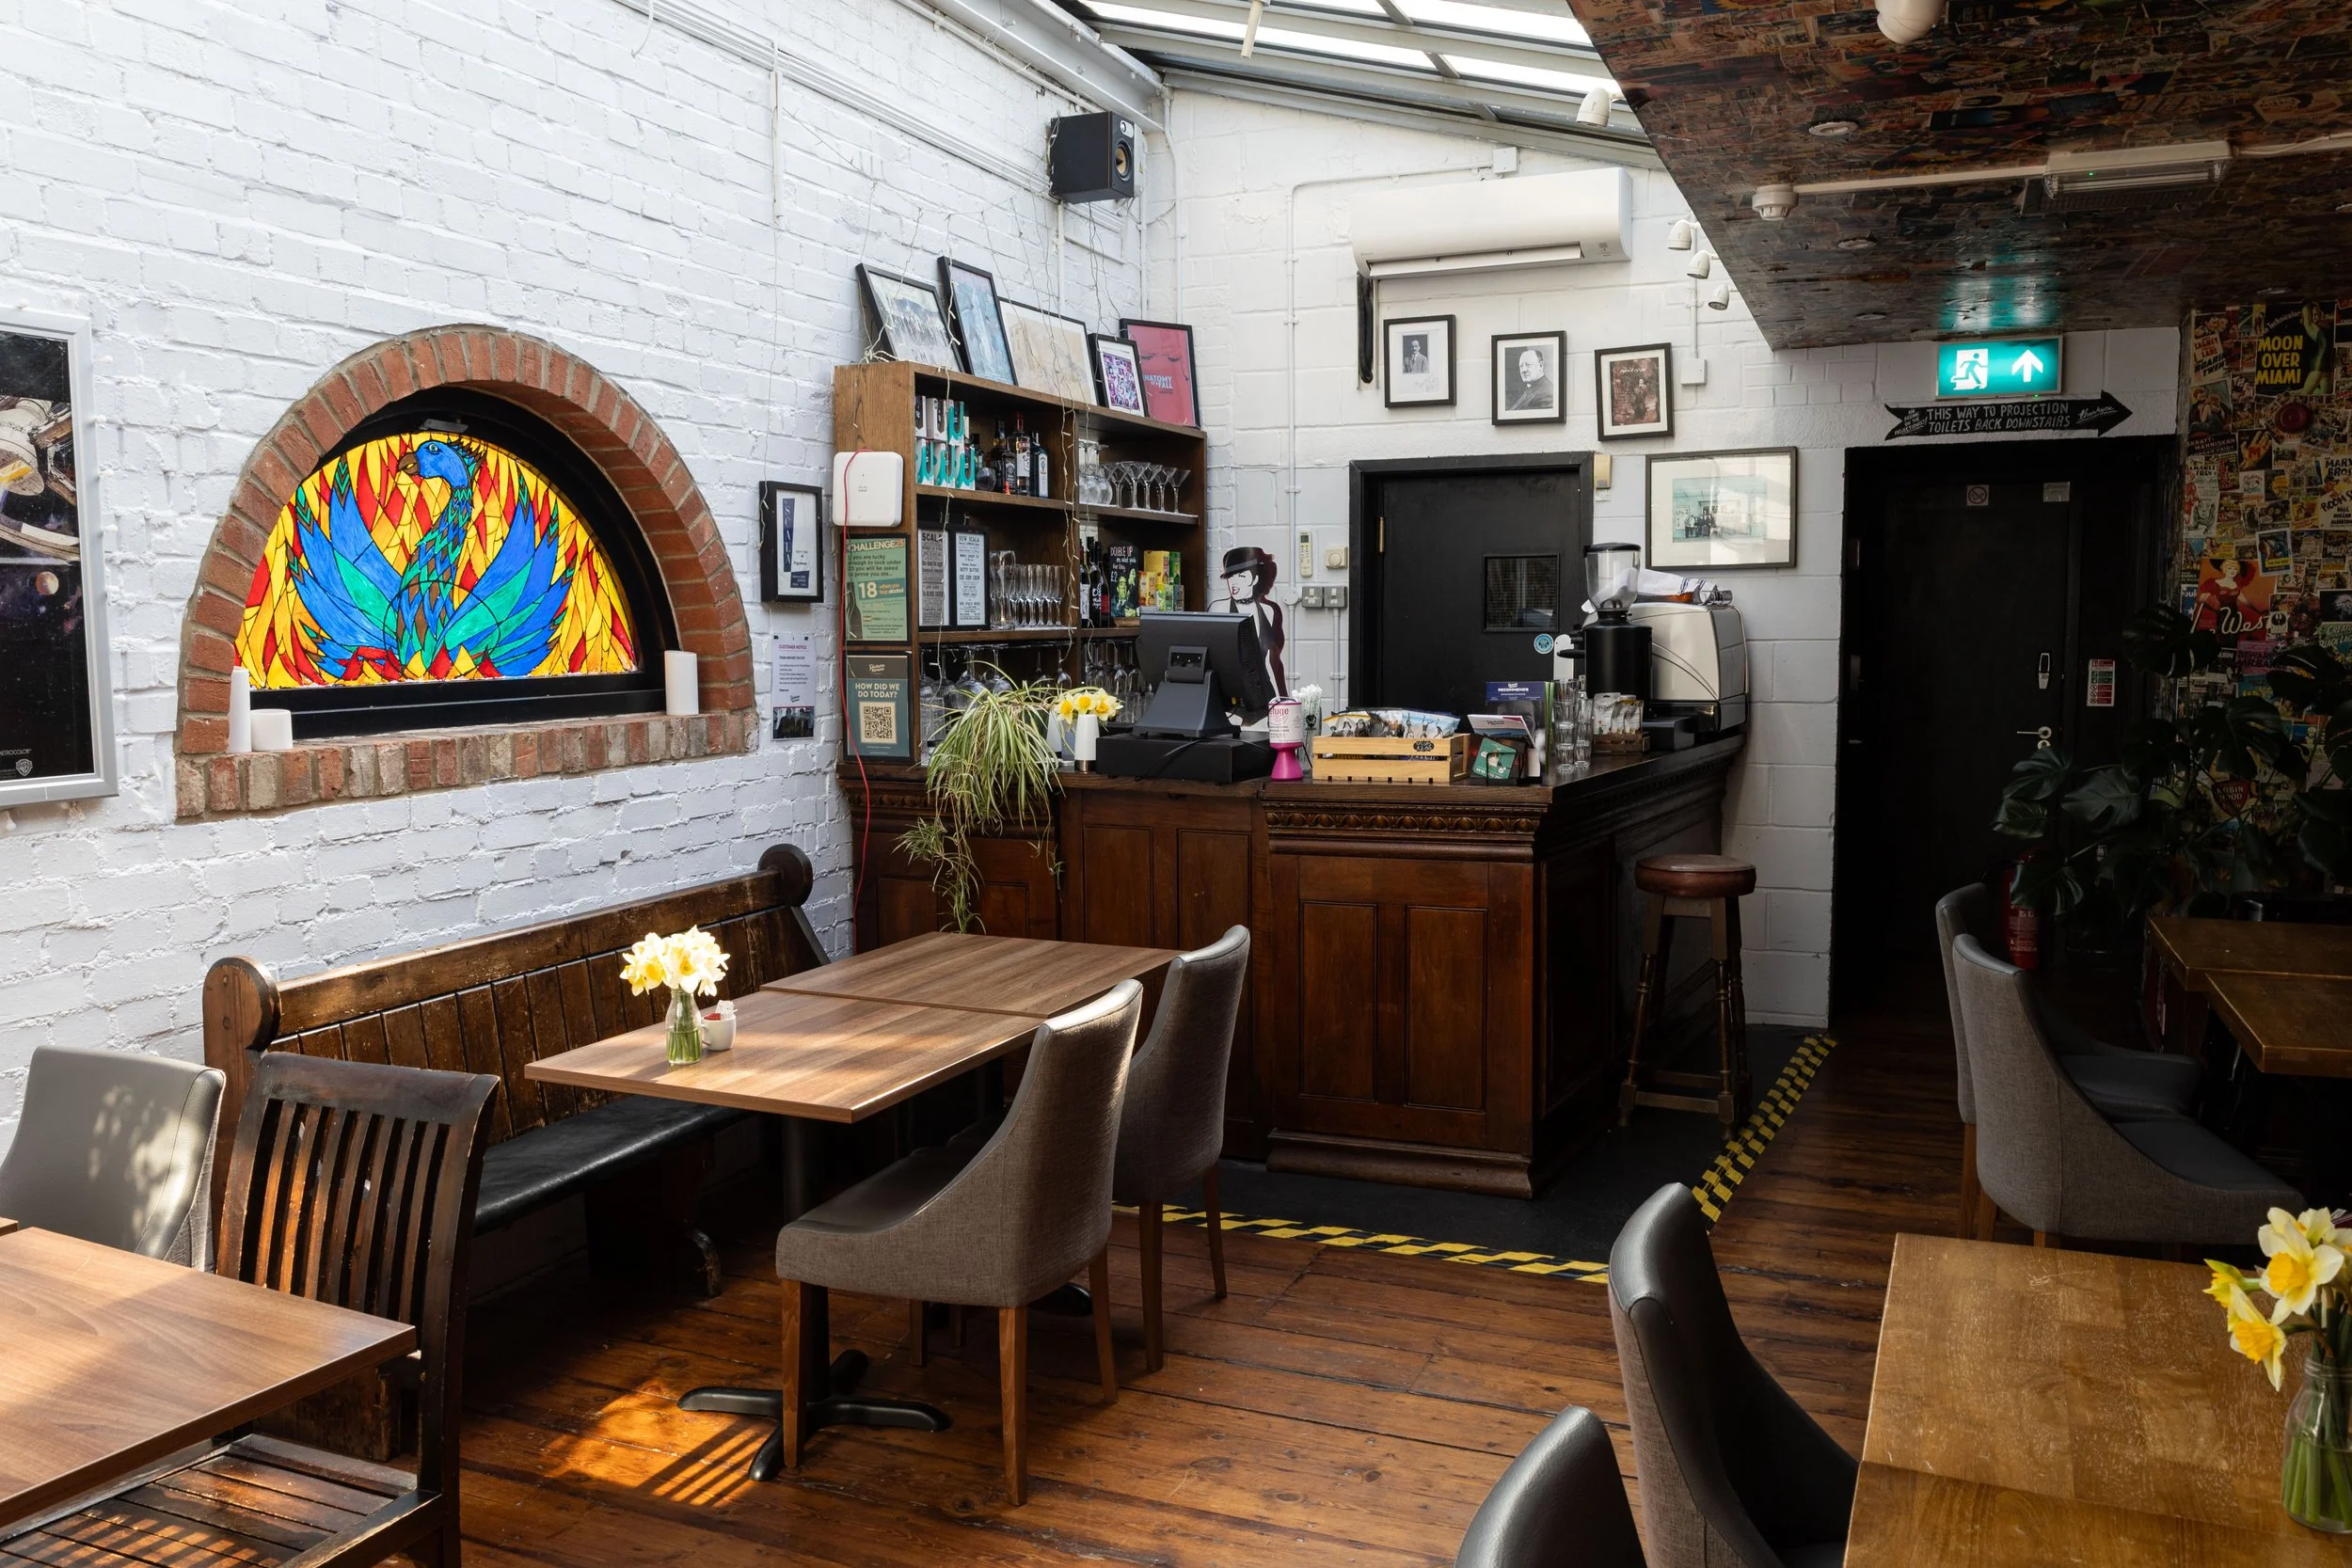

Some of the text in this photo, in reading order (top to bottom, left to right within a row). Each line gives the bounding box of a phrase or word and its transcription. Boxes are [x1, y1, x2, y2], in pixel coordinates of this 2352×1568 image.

[2266, 311, 2301, 330] Technicolor
[2258, 335, 2304, 352] MOON
[2261, 352, 2300, 368] OVER
[2257, 368, 2301, 385] MIAMI
[1926, 402, 2069, 420] THIS WAY TO PROJECTION
[1929, 415, 2070, 433] TOILETS BACK DOWNSTAIRS
[2325, 458, 2352, 468] MARX
[2328, 467, 2352, 476] BROS
[2320, 495, 2347, 512] ROOM
[922, 533, 943, 542] SCALA
[1110, 546, 1133, 556] DOUBLE UP
[1111, 571, 1118, 582] £2
[859, 581, 877, 599] 18
[1270, 708, 1288, 716] efuge
